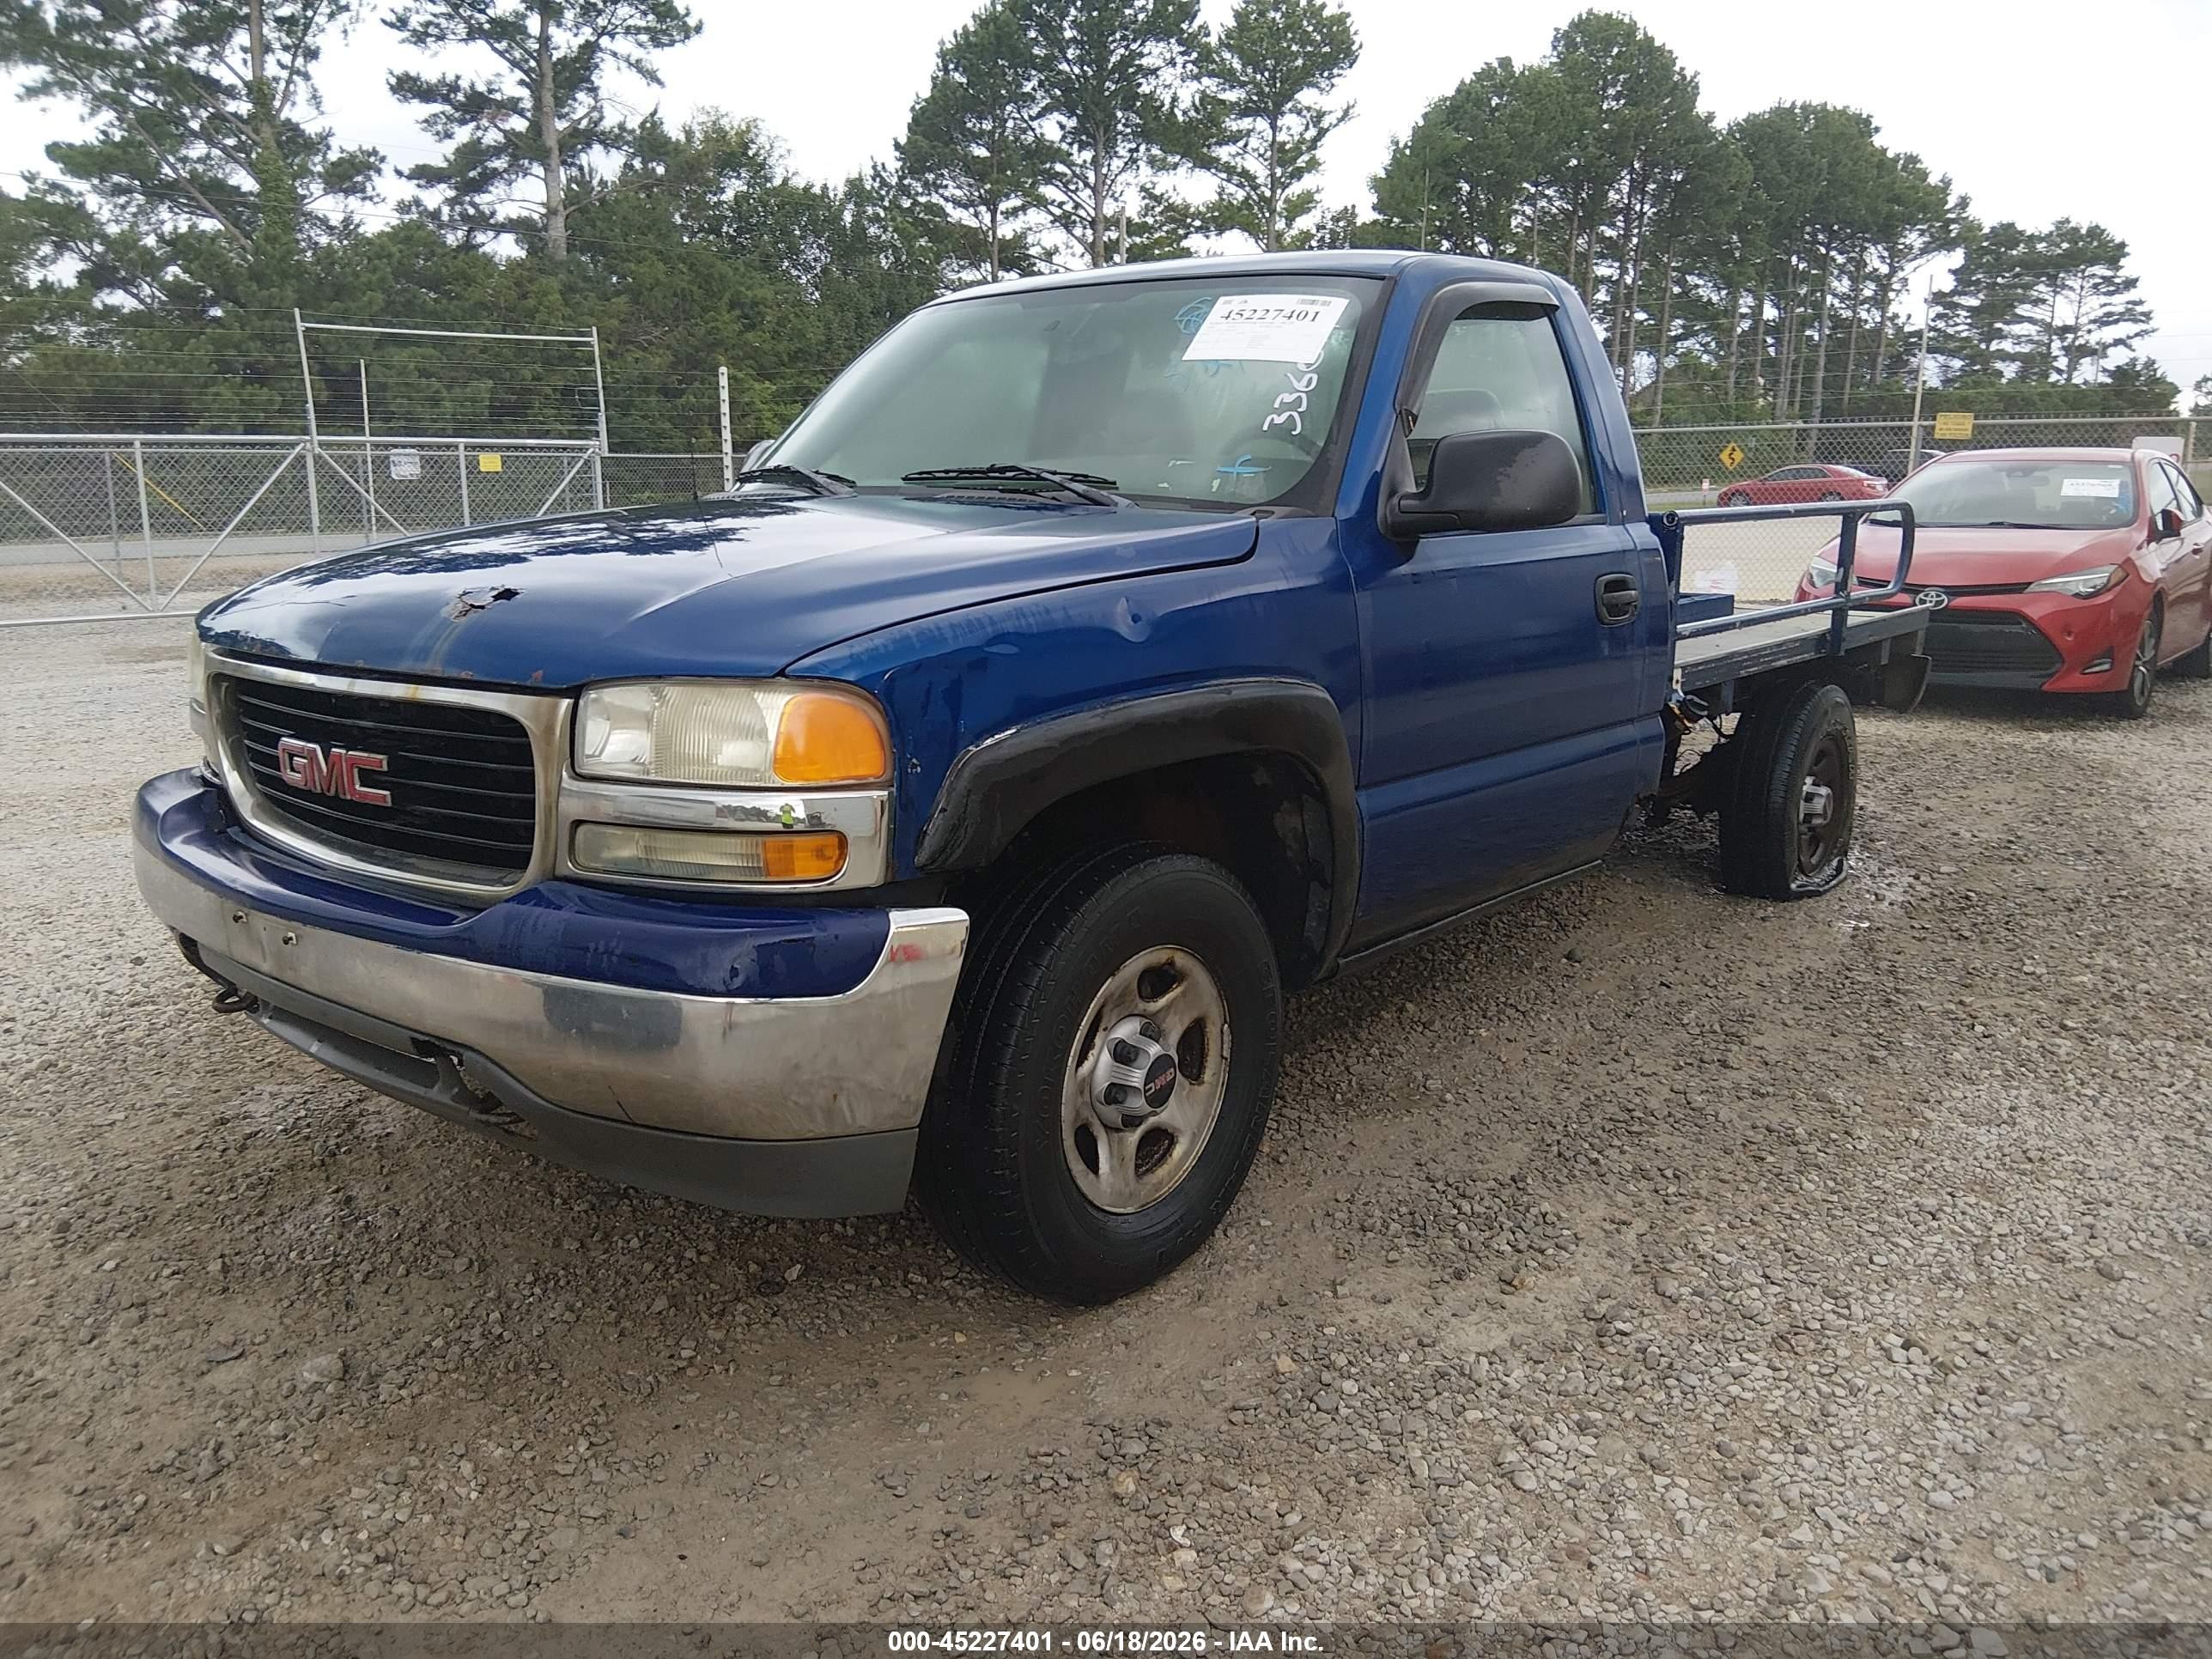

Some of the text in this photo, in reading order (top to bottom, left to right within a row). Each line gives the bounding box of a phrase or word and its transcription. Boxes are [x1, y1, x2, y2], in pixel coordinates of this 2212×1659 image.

[1220, 308, 1322, 323] 45227401
[277, 737, 392, 807] GMC
[1145, 1067, 1176, 1097] GMC
